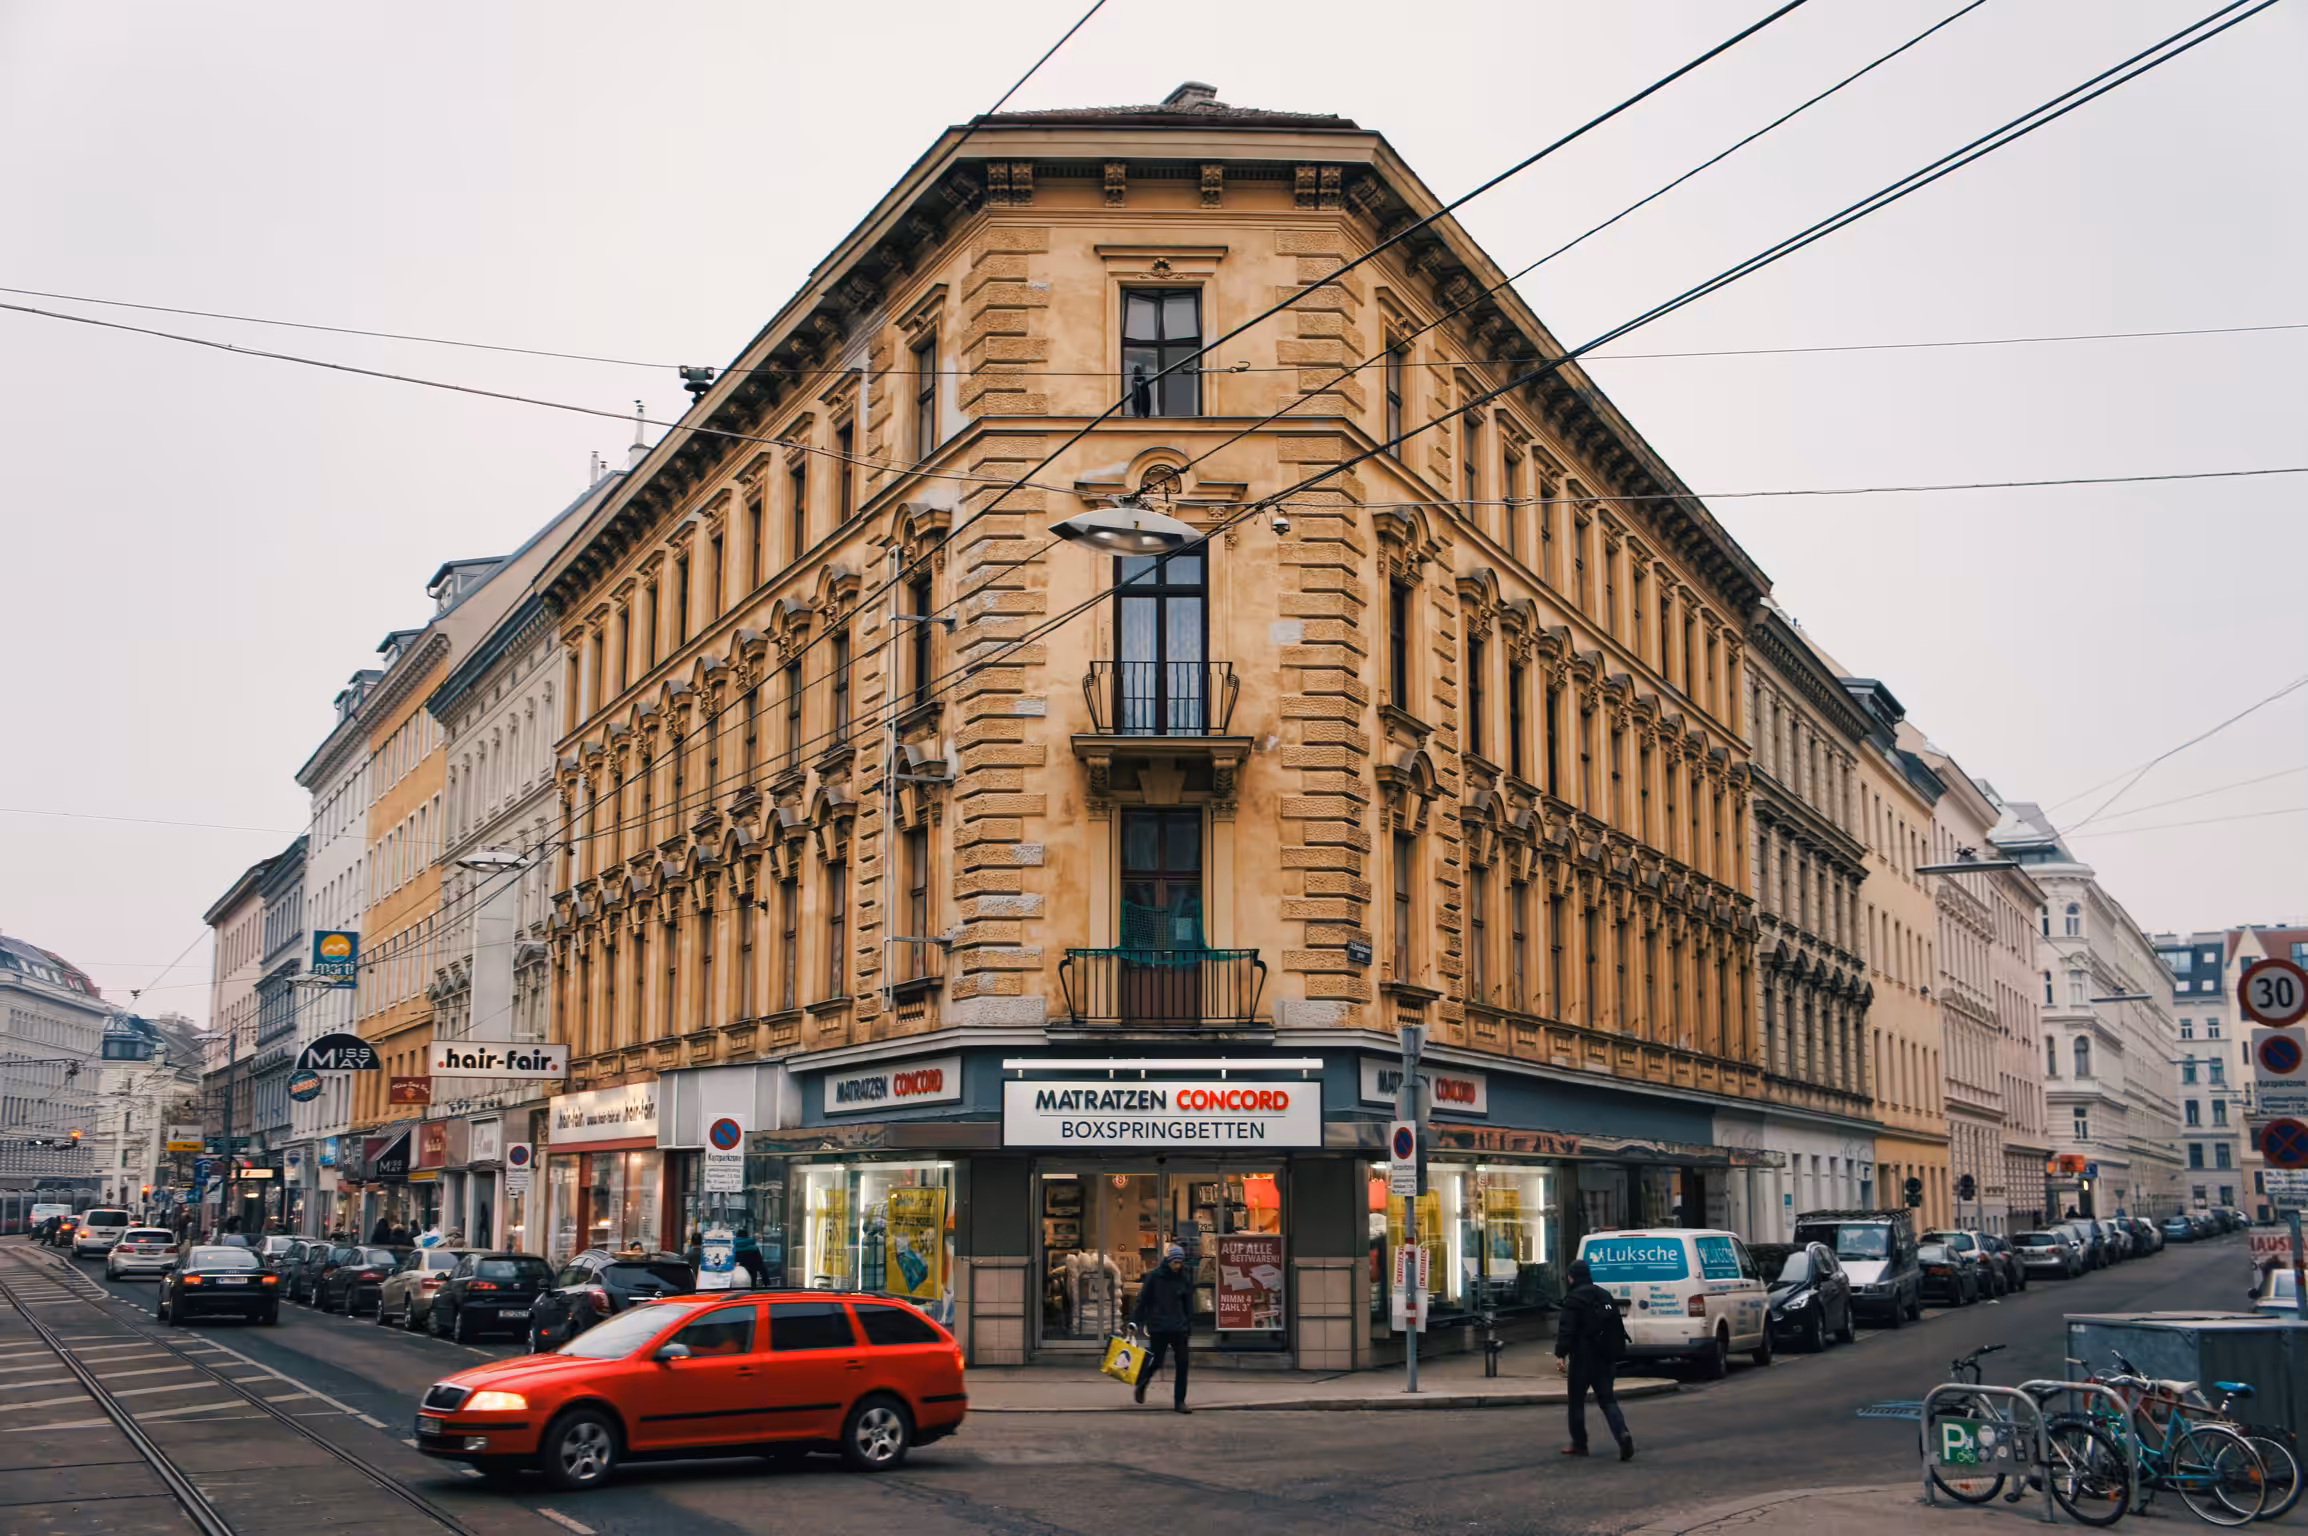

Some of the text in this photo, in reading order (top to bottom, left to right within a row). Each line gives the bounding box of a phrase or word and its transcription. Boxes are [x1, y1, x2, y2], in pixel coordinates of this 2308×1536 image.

[2255, 976, 2294, 1009] 30
[836, 1068, 943, 1103] MATRATZEN CONCORD
[1035, 1089, 1289, 1111] MATRATZEN CONCORD
[1061, 1121, 1265, 1139] BOXSPRINGBETTEN
[1221, 1242, 1273, 1255] AUF ALLE
[1607, 1246, 1678, 1263] Luksche
[1230, 1254, 1280, 1264] BETTWAREN!
[1220, 1294, 1252, 1303] NIMM 4
[1220, 1303, 1241, 1312] ZAHL
[1942, 1423, 1966, 1460] P
